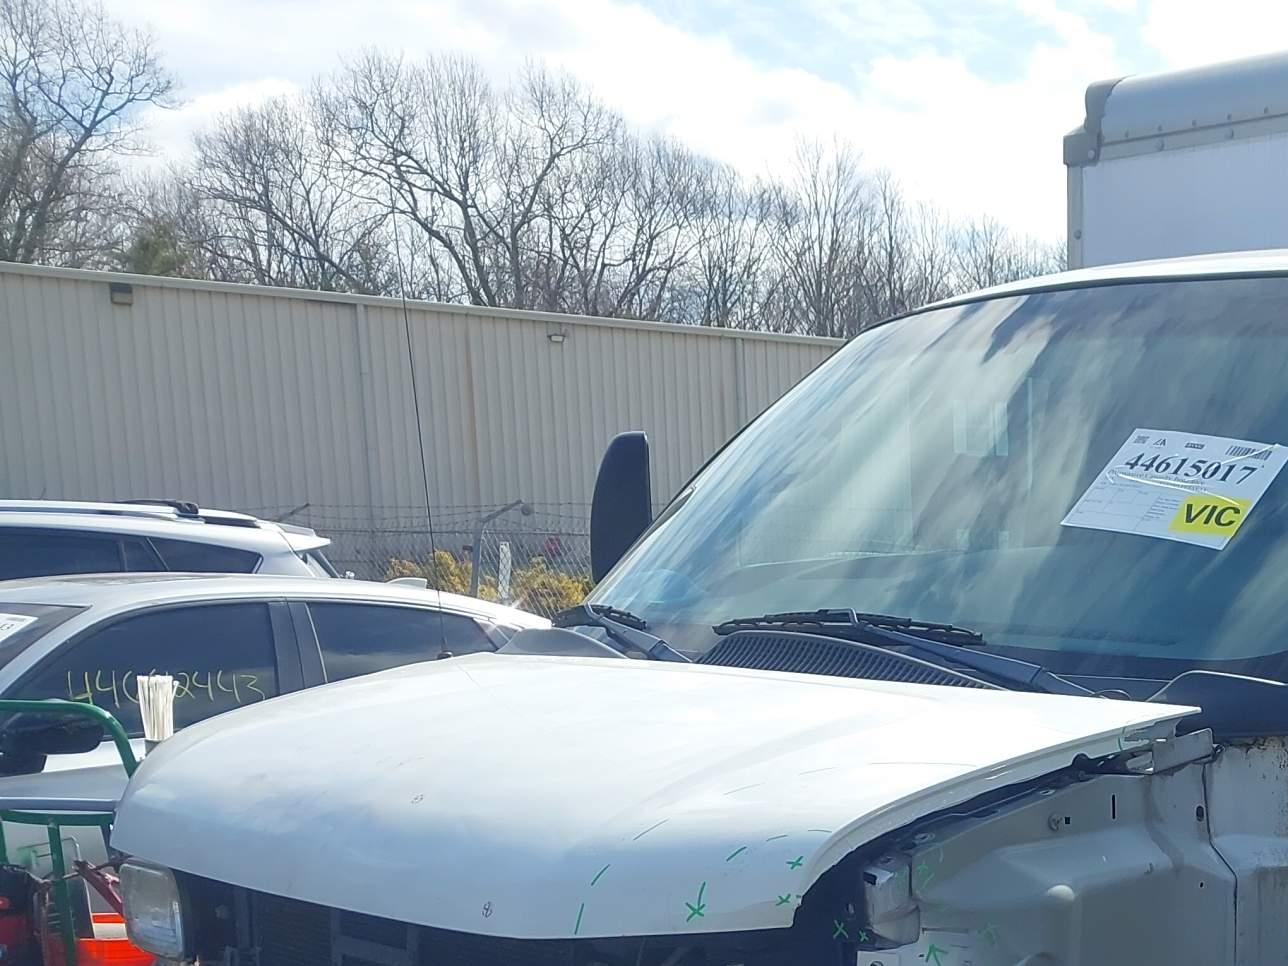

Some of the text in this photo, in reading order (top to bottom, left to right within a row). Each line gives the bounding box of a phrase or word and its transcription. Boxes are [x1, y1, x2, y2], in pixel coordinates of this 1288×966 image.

[1124, 452, 1257, 485] 44615017
[1184, 503, 1241, 527] VIC
[67, 669, 266, 709] 442443
